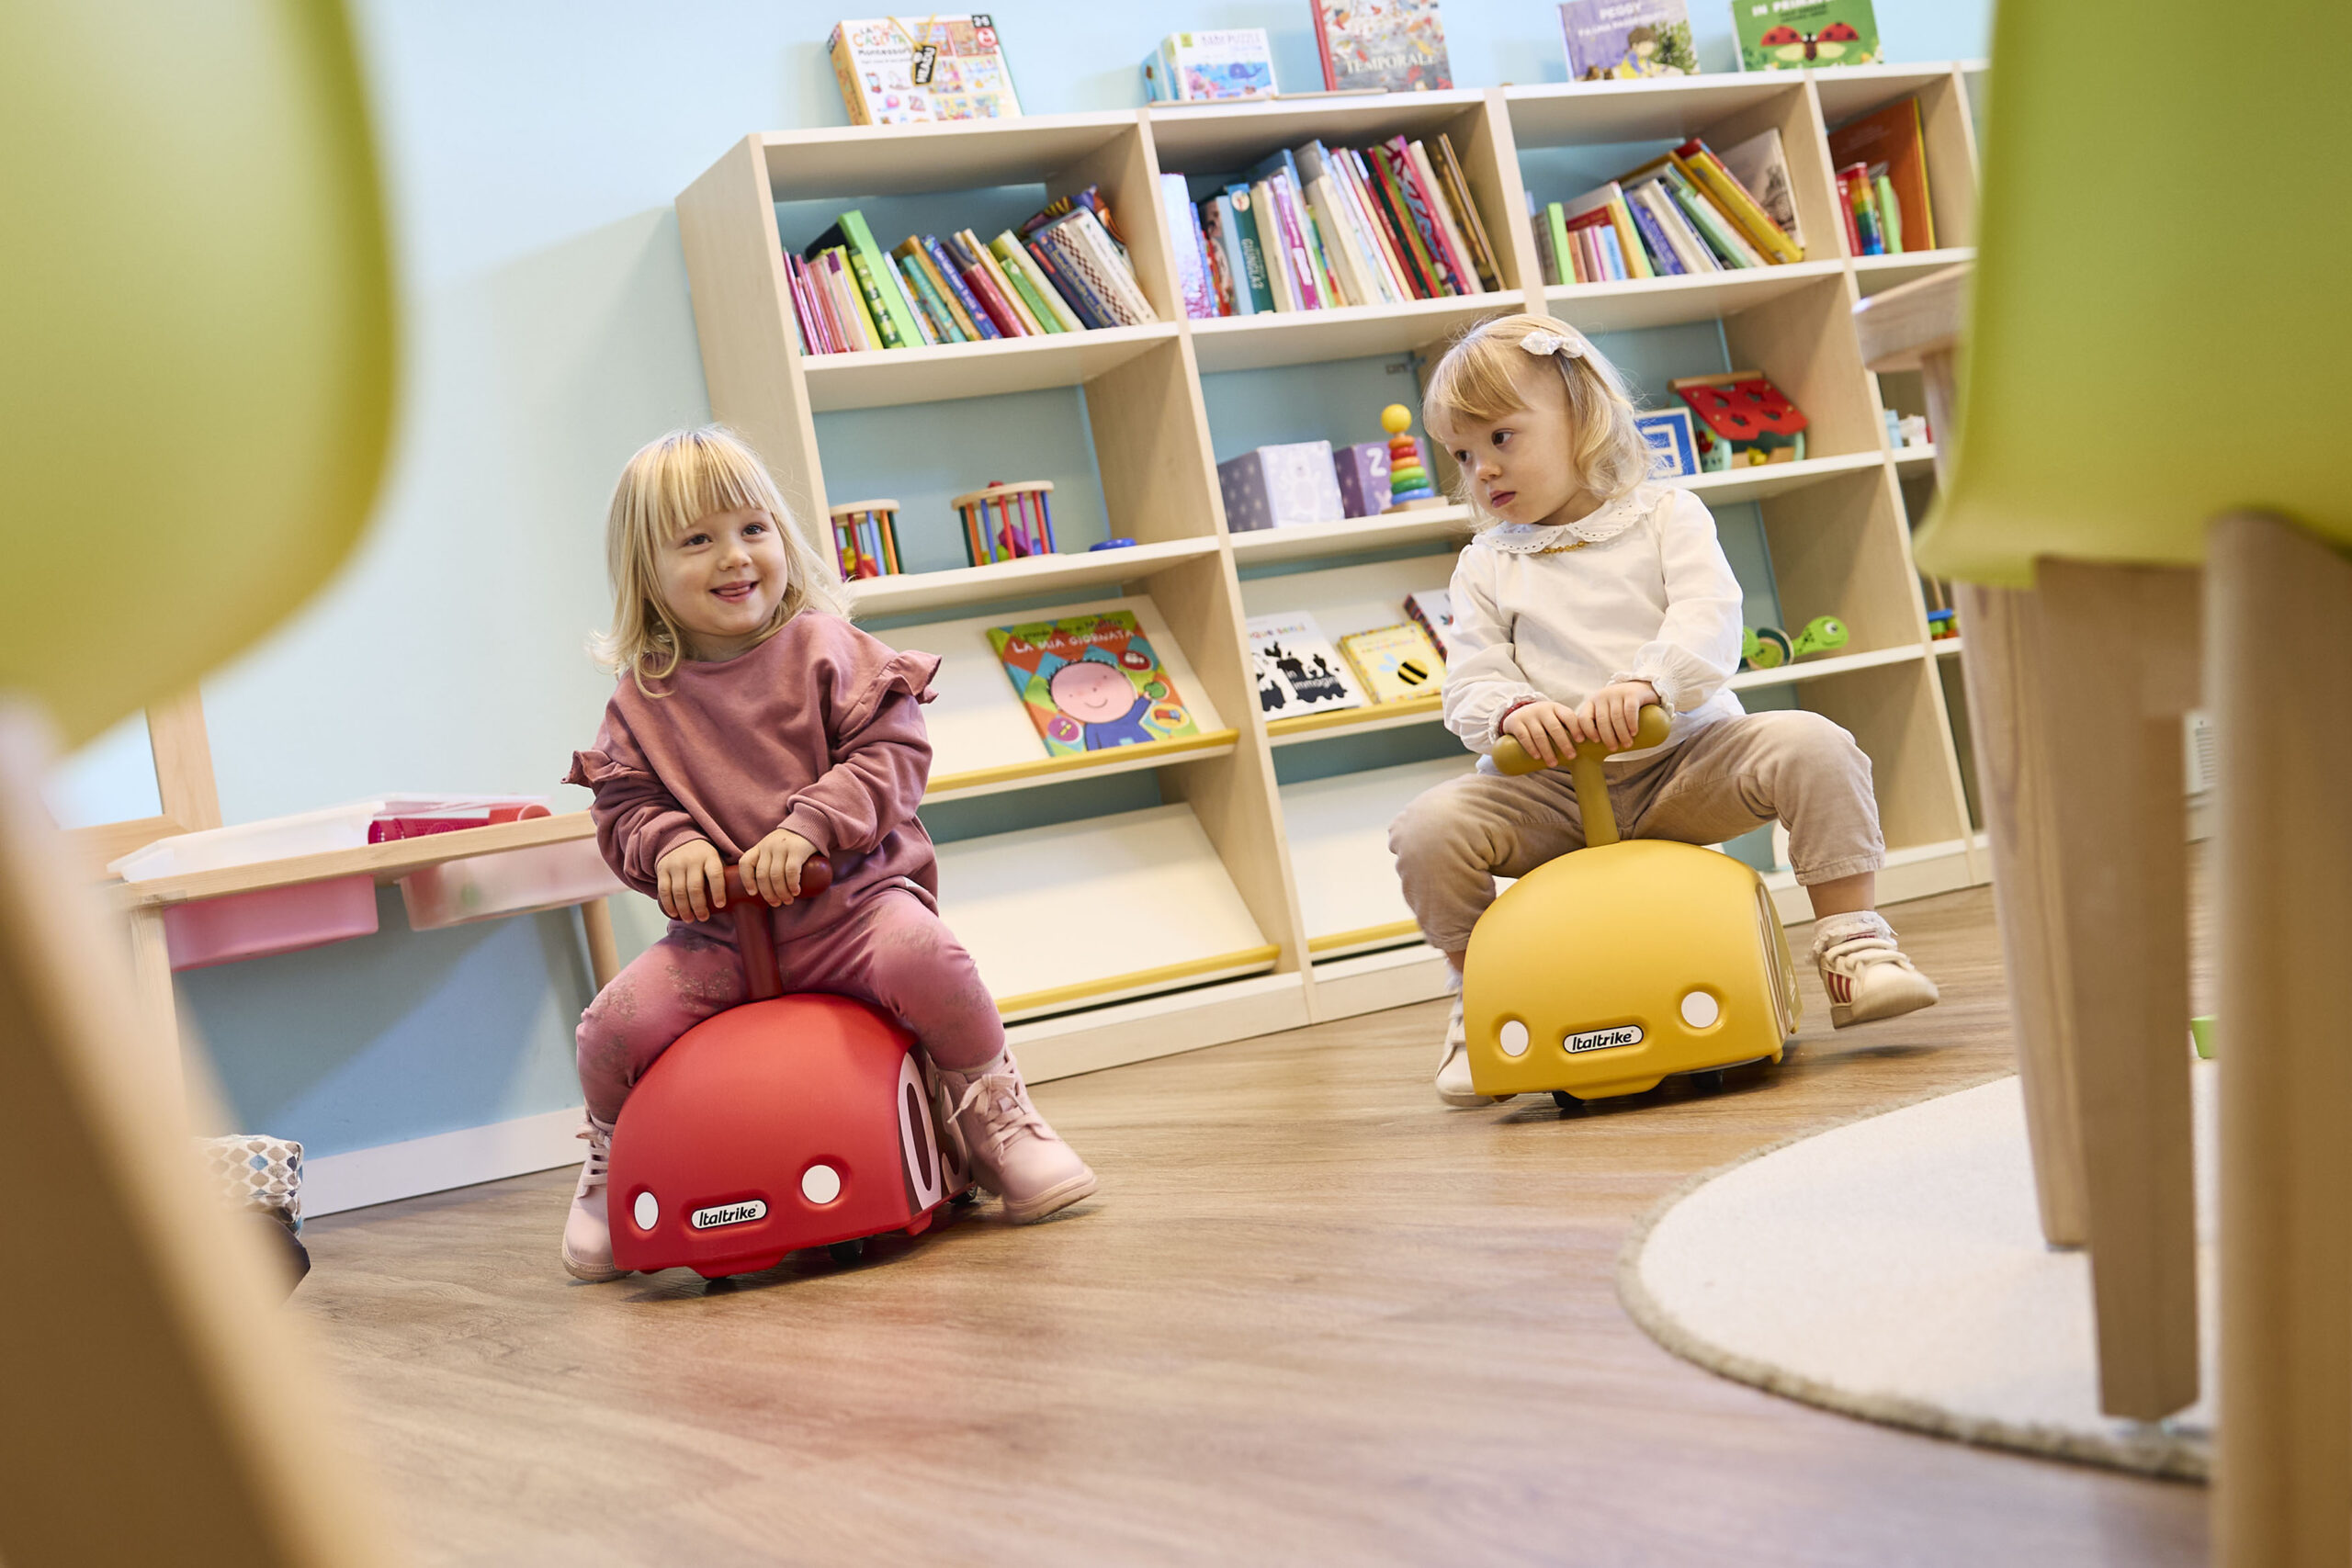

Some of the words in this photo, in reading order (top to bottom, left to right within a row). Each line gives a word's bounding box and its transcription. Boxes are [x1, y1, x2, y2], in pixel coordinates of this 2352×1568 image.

[1345, 51, 1435, 73] TEMPORALE
[1012, 641, 1034, 653] LA
[1037, 637, 1065, 650] MIA
[1069, 628, 1135, 647] GIORNATA
[1572, 1032, 1633, 1051] Italtrike
[699, 1206, 756, 1227] Italtrike
